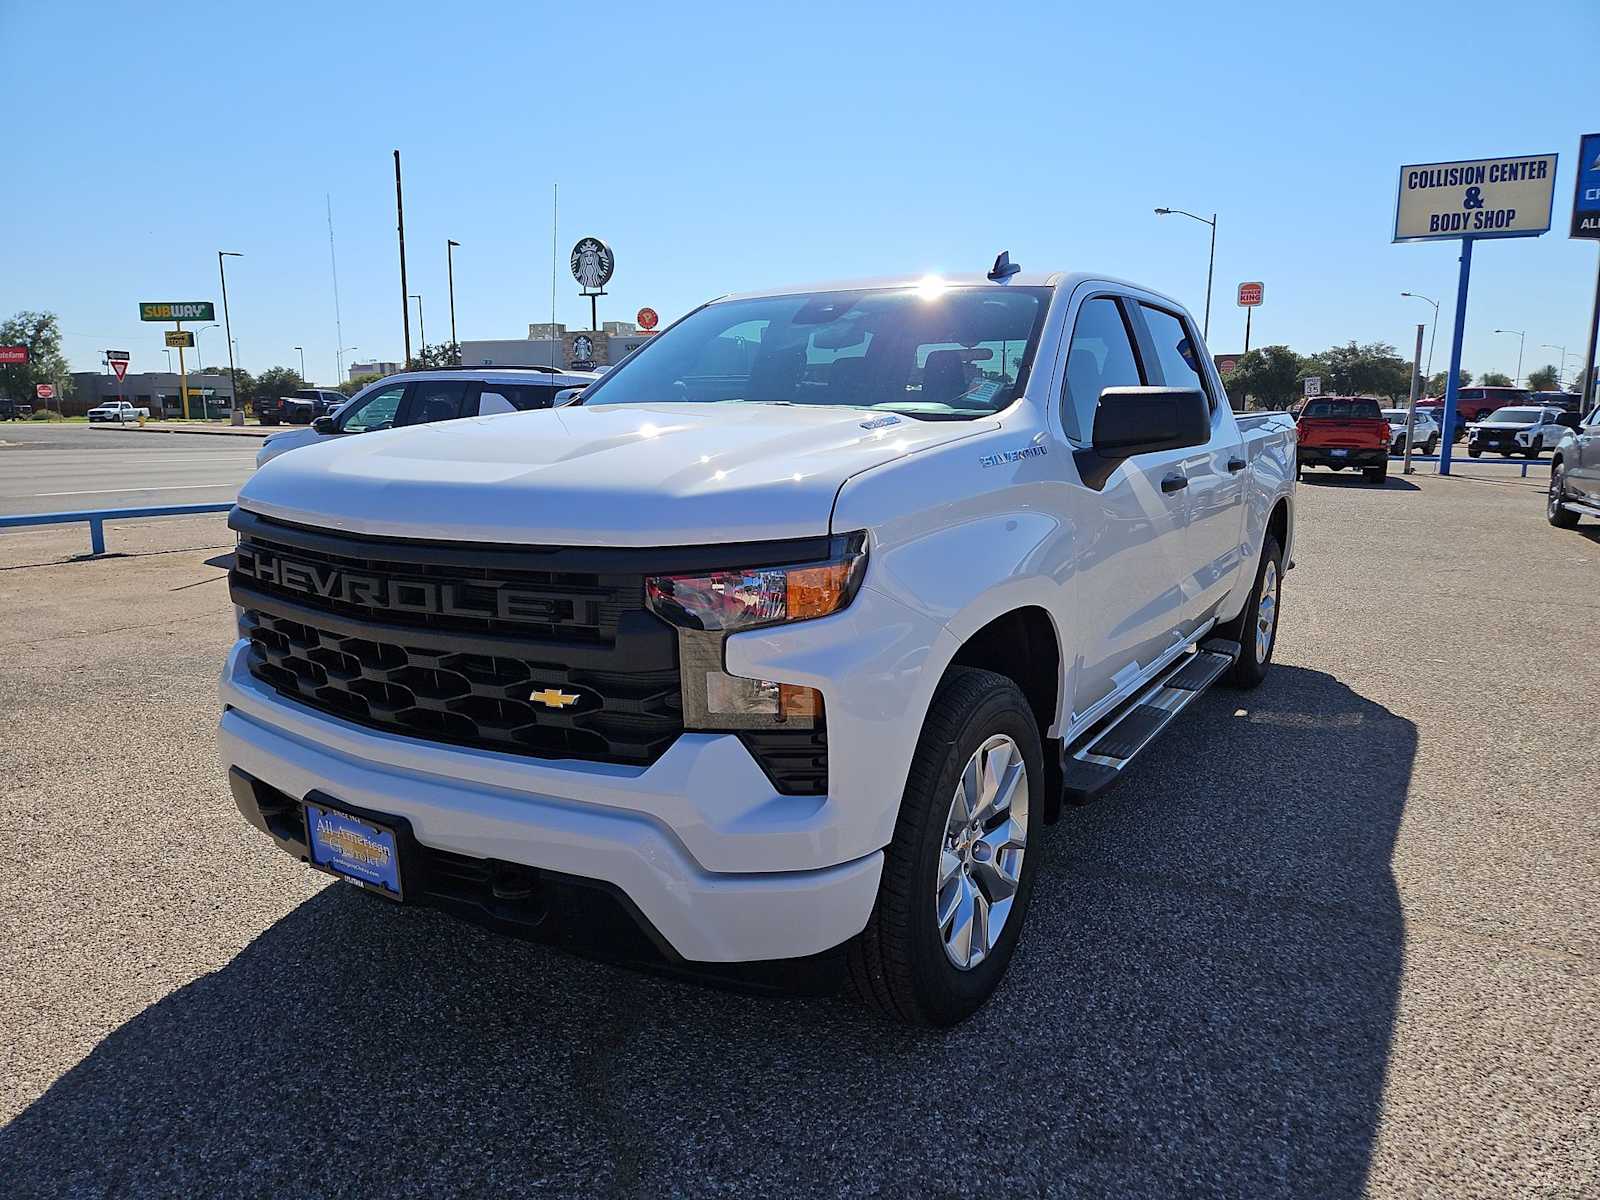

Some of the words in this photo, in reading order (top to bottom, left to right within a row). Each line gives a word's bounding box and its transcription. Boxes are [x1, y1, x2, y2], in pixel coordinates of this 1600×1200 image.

[1408, 165, 1486, 190] COLLISION
[1488, 160, 1548, 183] CENTER
[1463, 186, 1484, 210] &
[1429, 212, 1471, 232] BODY
[1473, 208, 1517, 230] SHOP
[143, 304, 202, 318] SUBWAY
[235, 549, 612, 625] CHEVROLET
